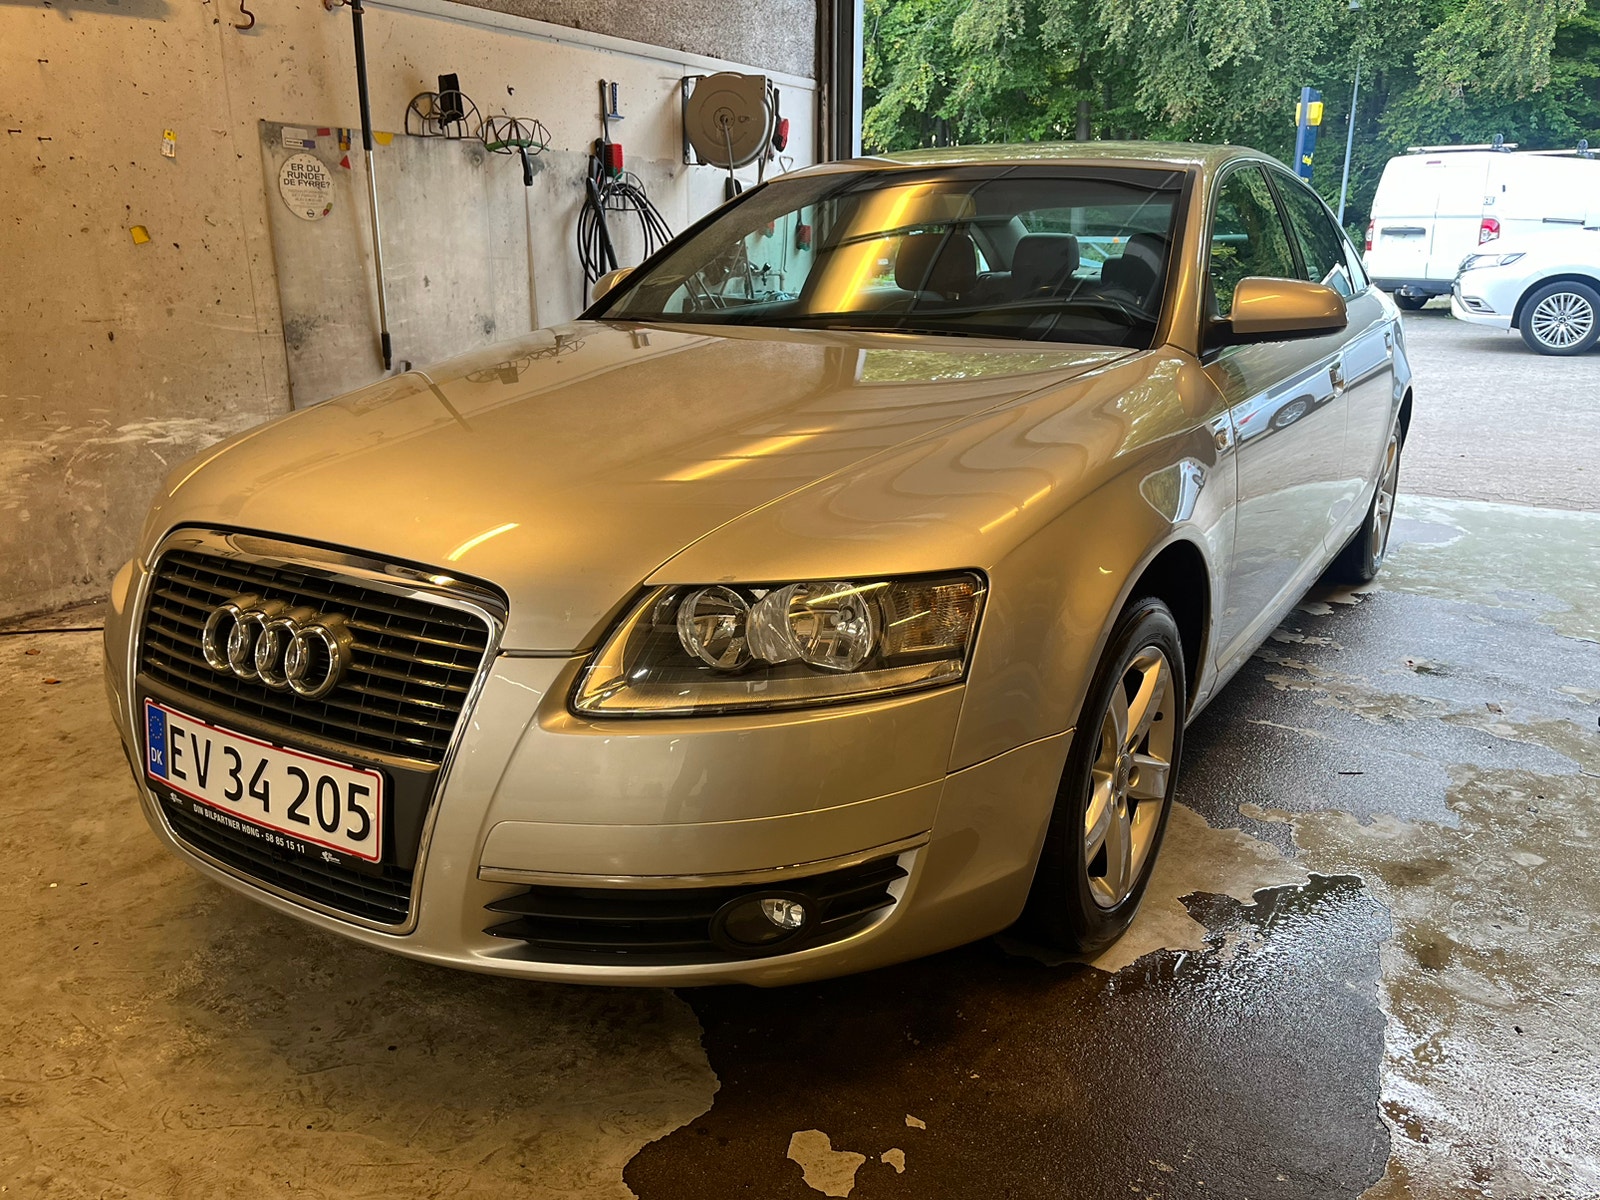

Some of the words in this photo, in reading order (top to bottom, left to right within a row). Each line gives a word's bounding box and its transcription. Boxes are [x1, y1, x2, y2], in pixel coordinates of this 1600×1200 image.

[287, 171, 325, 180] RUNDET
[291, 163, 304, 171] ER
[306, 164, 320, 173] DU
[283, 178, 296, 186] DE
[298, 180, 330, 188] FYRRE?
[151, 746, 163, 766] DK
[170, 724, 211, 789] EV
[223, 746, 270, 813] 34
[287, 766, 370, 841] 205
[193, 803, 204, 815] DIN
[204, 809, 241, 831] BILPARTNER
[265, 832, 275, 843] 58
[275, 836, 285, 847] 85
[286, 840, 295, 850] 15
[296, 843, 305, 854] 11
